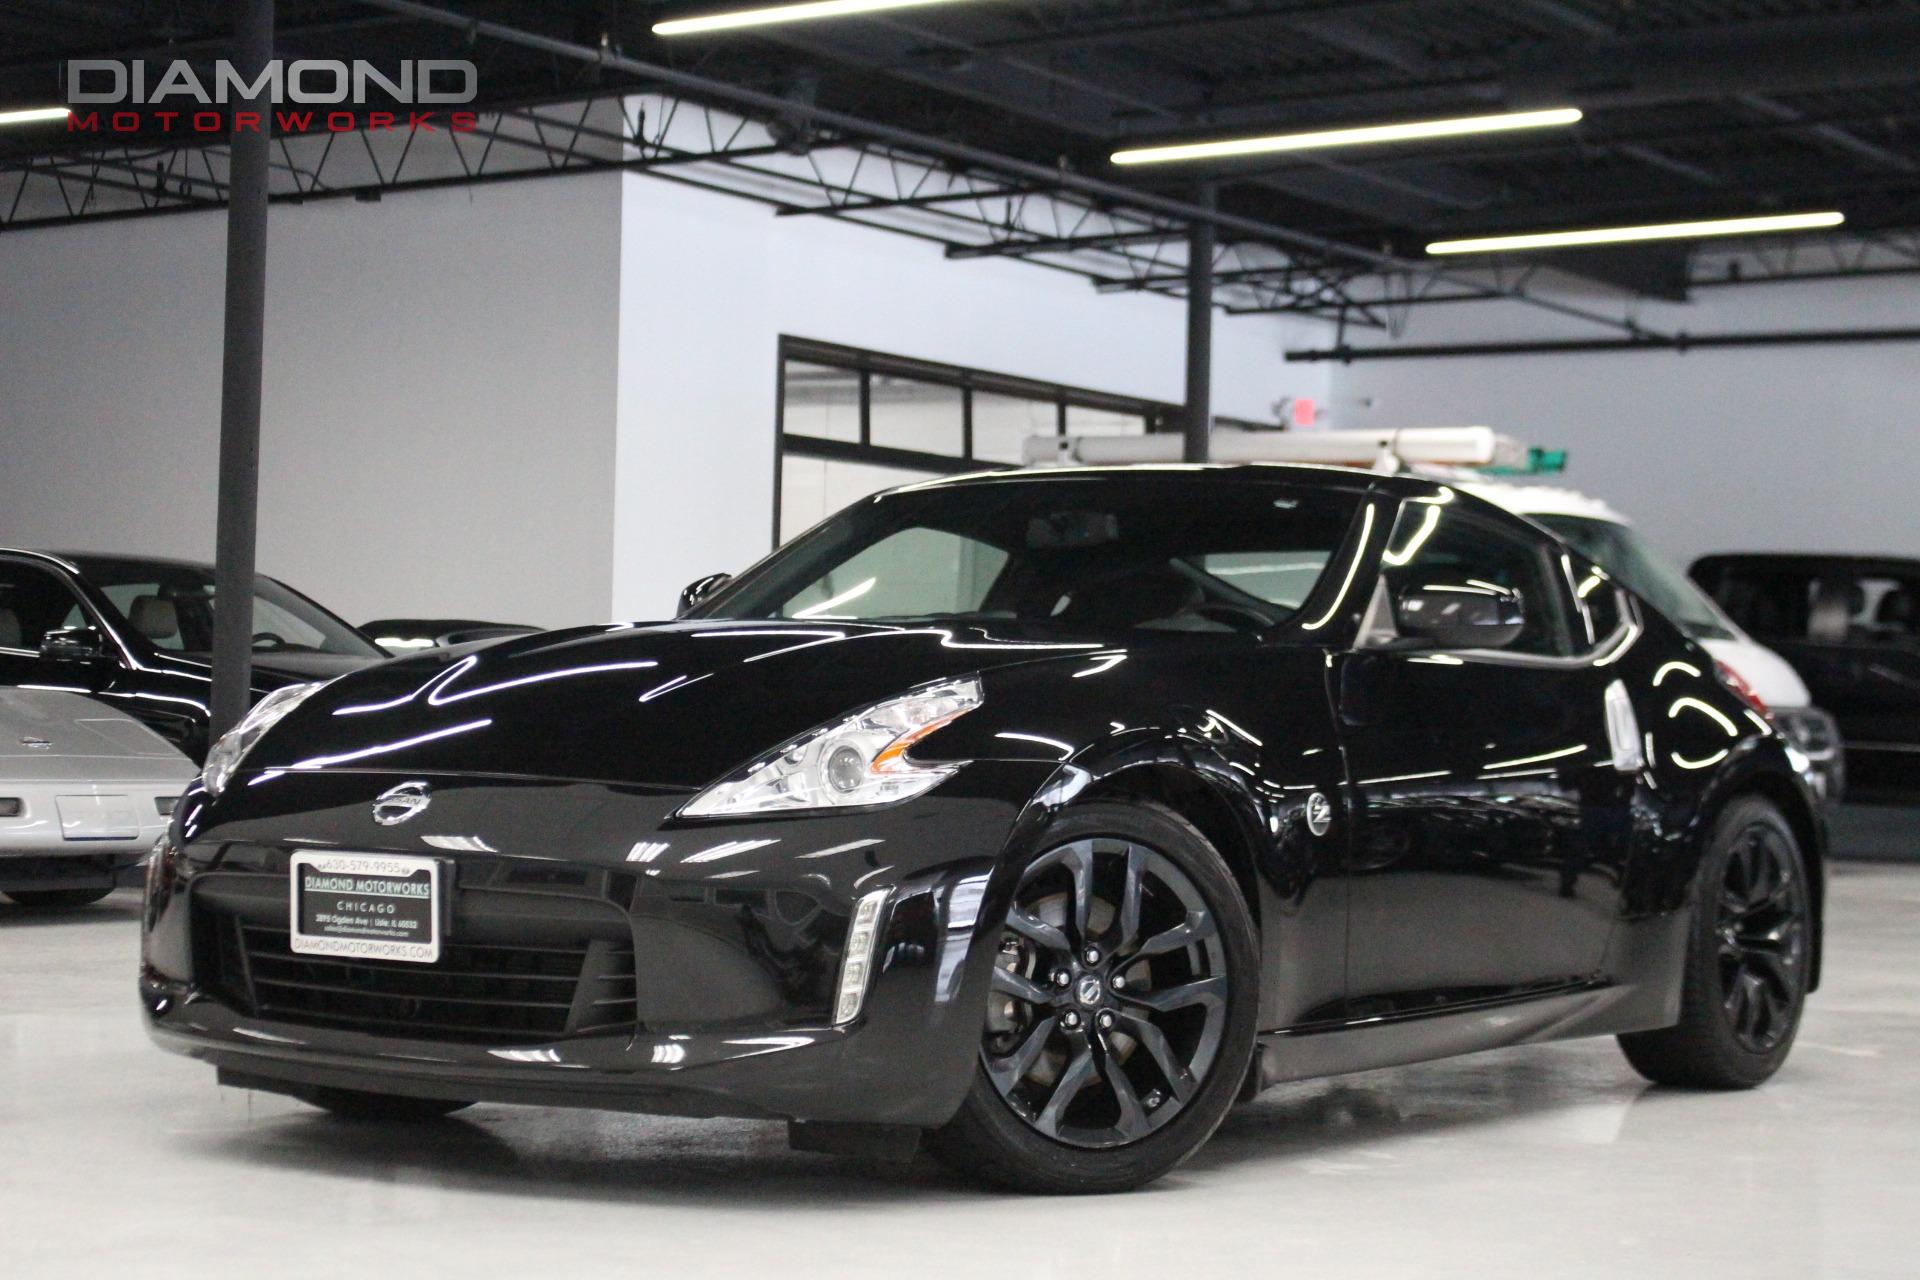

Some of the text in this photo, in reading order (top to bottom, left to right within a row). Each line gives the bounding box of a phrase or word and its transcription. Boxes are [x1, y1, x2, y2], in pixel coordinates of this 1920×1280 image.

[305, 876, 429, 896] DIAMOND MOTORWORKS
[336, 901, 395, 914] CHICAGO
[294, 938, 433, 959] DIAMONDMOTORWORKS.COM
